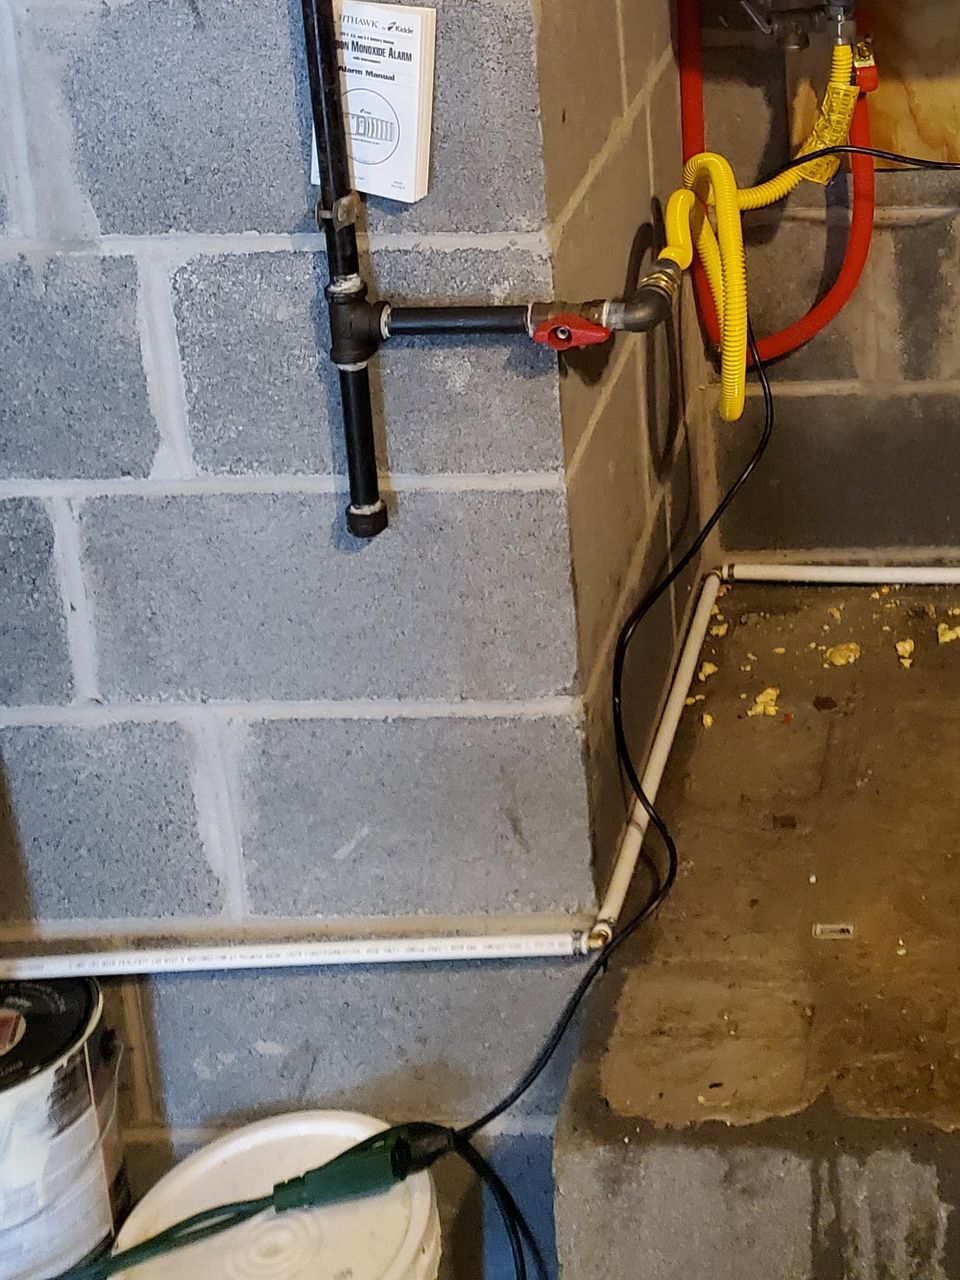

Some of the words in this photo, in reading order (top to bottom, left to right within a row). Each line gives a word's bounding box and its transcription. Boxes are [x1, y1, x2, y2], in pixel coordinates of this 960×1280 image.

[339, 13, 379, 29] HTHAWK
[395, 24, 414, 35] Kidde
[351, 40, 387, 58] MONOXIDE
[388, 46, 413, 63] ALARM
[365, 69, 396, 82] Manual
